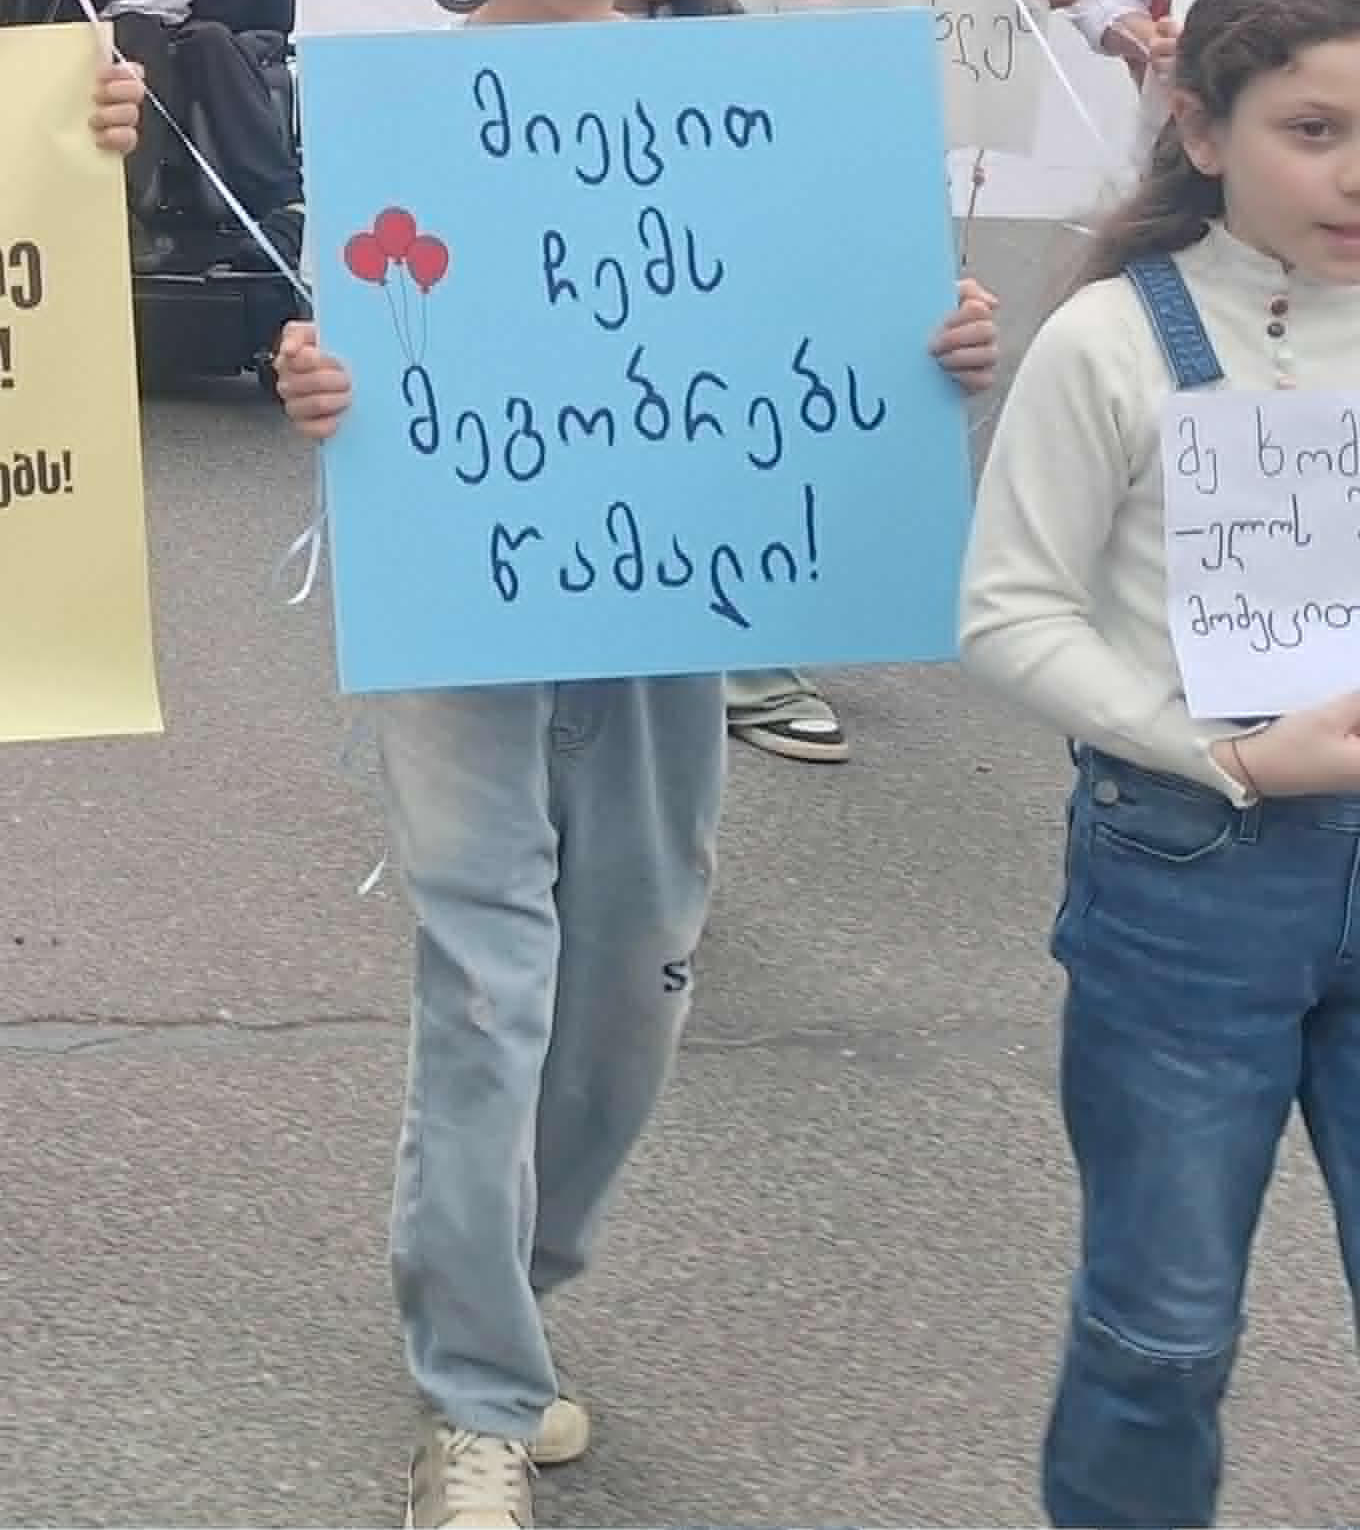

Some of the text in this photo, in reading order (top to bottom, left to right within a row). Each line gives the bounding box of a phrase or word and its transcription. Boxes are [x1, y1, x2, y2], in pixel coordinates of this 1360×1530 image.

[473, 68, 773, 186] მიეცით
[543, 206, 724, 330] ჩემს
[402, 337, 886, 484] მეგობრებს
[491, 484, 820, 629] წამალი!
